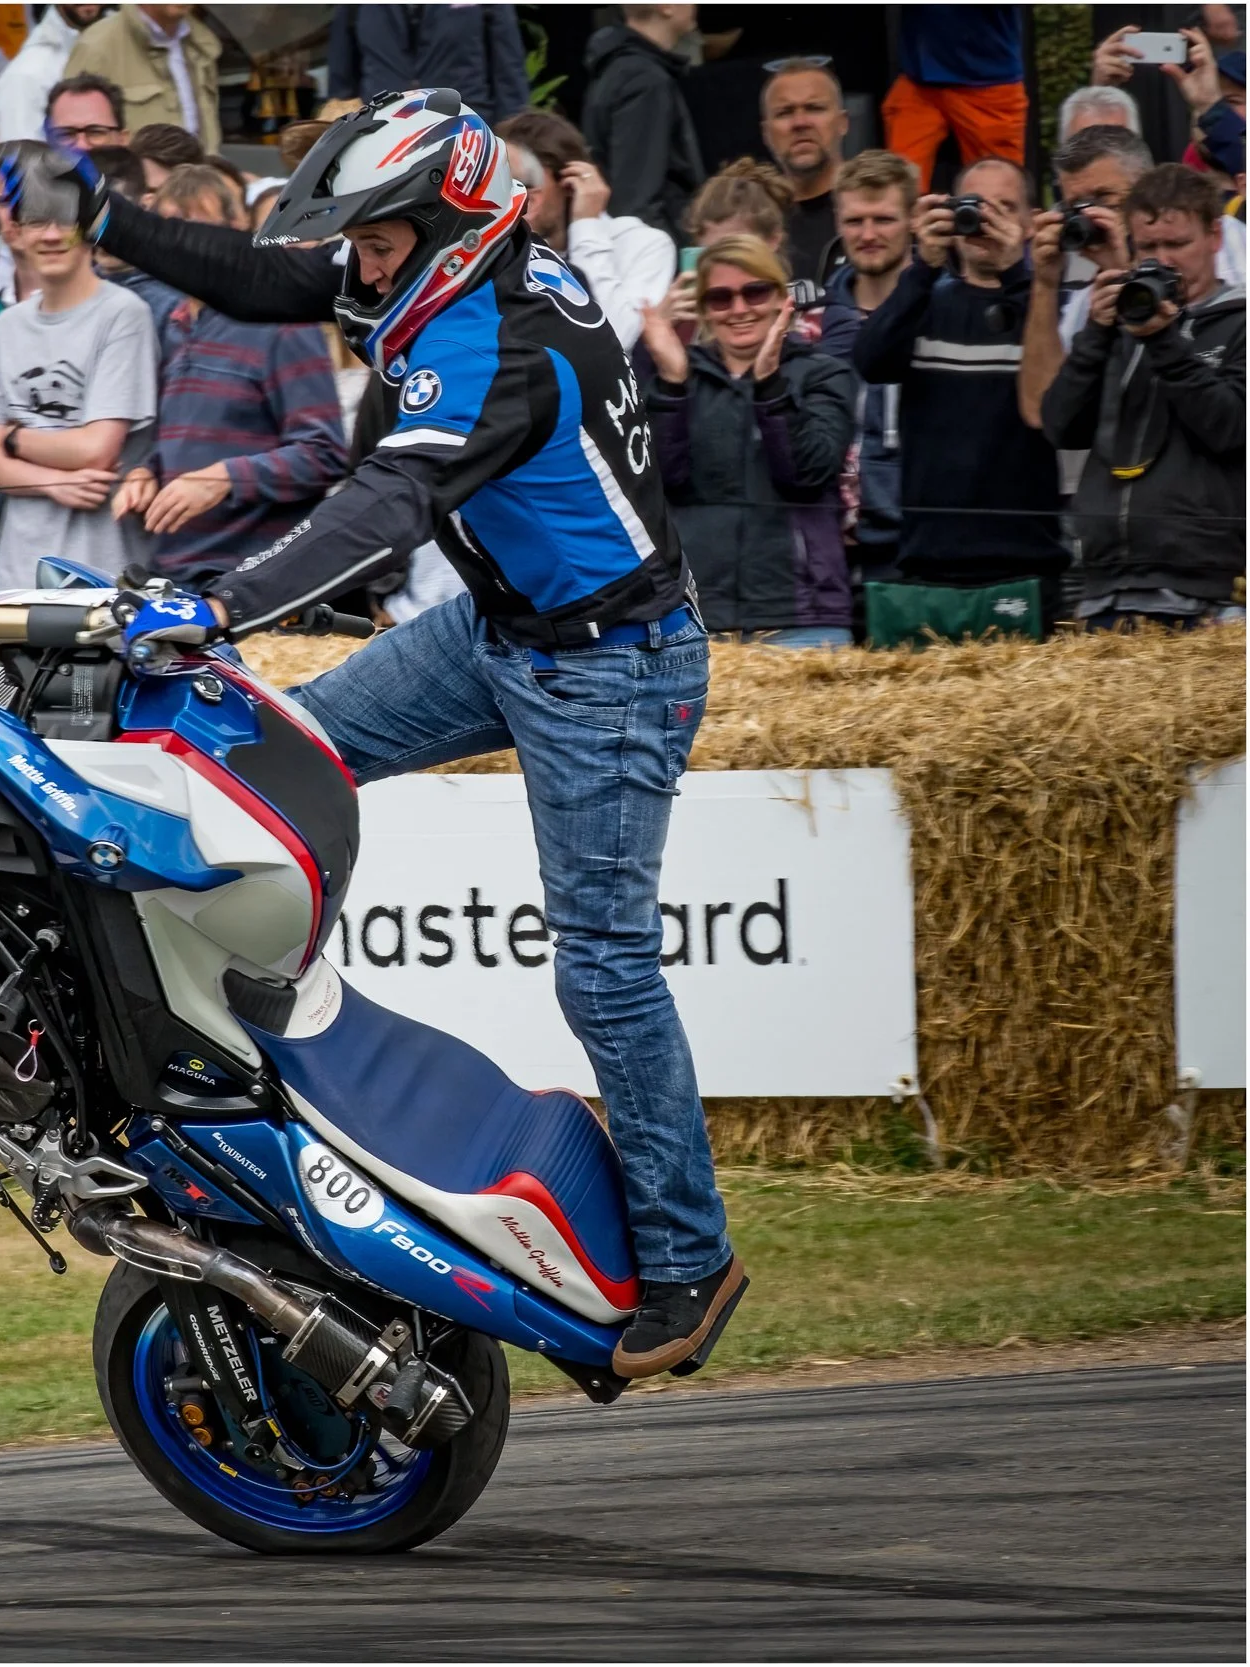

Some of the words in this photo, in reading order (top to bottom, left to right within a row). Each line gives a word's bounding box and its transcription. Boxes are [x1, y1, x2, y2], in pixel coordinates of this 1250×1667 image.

[167, 1063, 216, 1086] MAGURA
[218, 1140, 268, 1181] TOURATECH
[307, 1155, 371, 1213] 800
[497, 1216, 532, 1250] Mattie
[528, 1249, 564, 1289] Griffin
[189, 1313, 221, 1381] GOODRIDGE
[207, 1304, 258, 1402] METZELER
